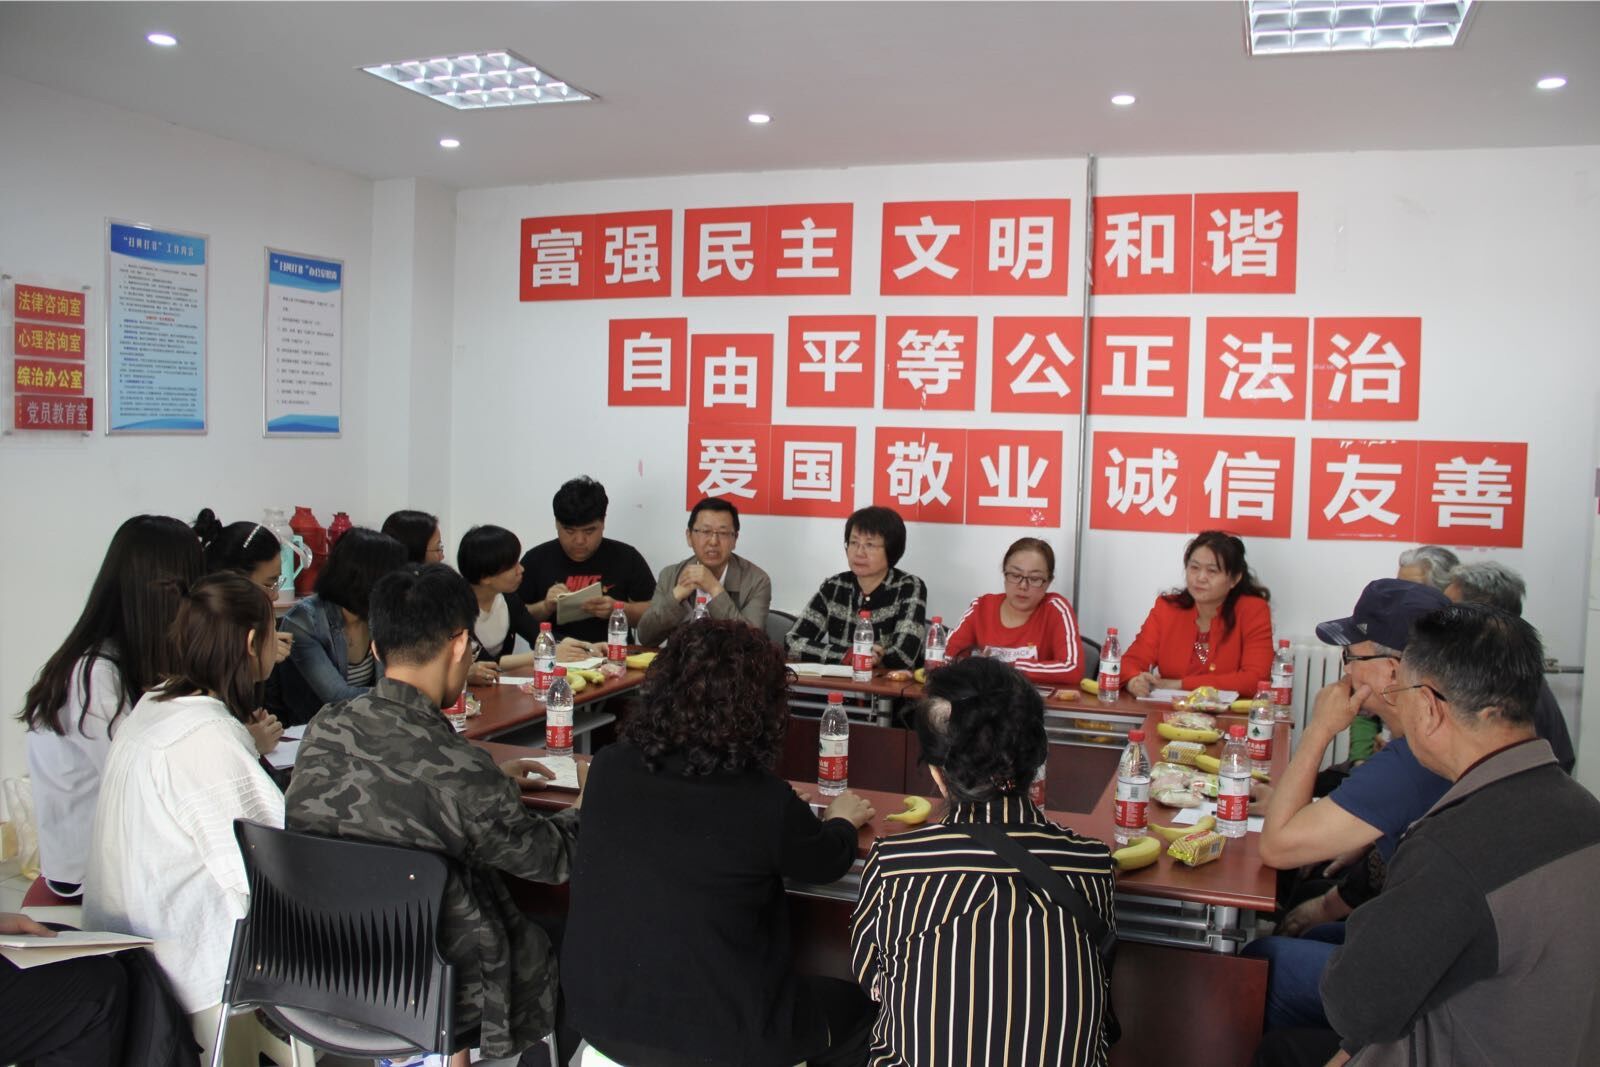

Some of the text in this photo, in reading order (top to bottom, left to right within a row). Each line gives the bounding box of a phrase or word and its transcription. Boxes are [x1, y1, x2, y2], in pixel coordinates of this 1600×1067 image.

[531, 208, 1283, 287] 富强 民主 文明 和谐
[18, 290, 81, 317] 法律咨询室
[18, 328, 81, 352] 心理咨询室
[17, 365, 83, 389] 综治办公室
[623, 330, 1405, 408] 自由 平等 公正 法治
[27, 400, 88, 425] 党员教育室
[698, 438, 1512, 529] 爱国 敬业 诚信 友善
